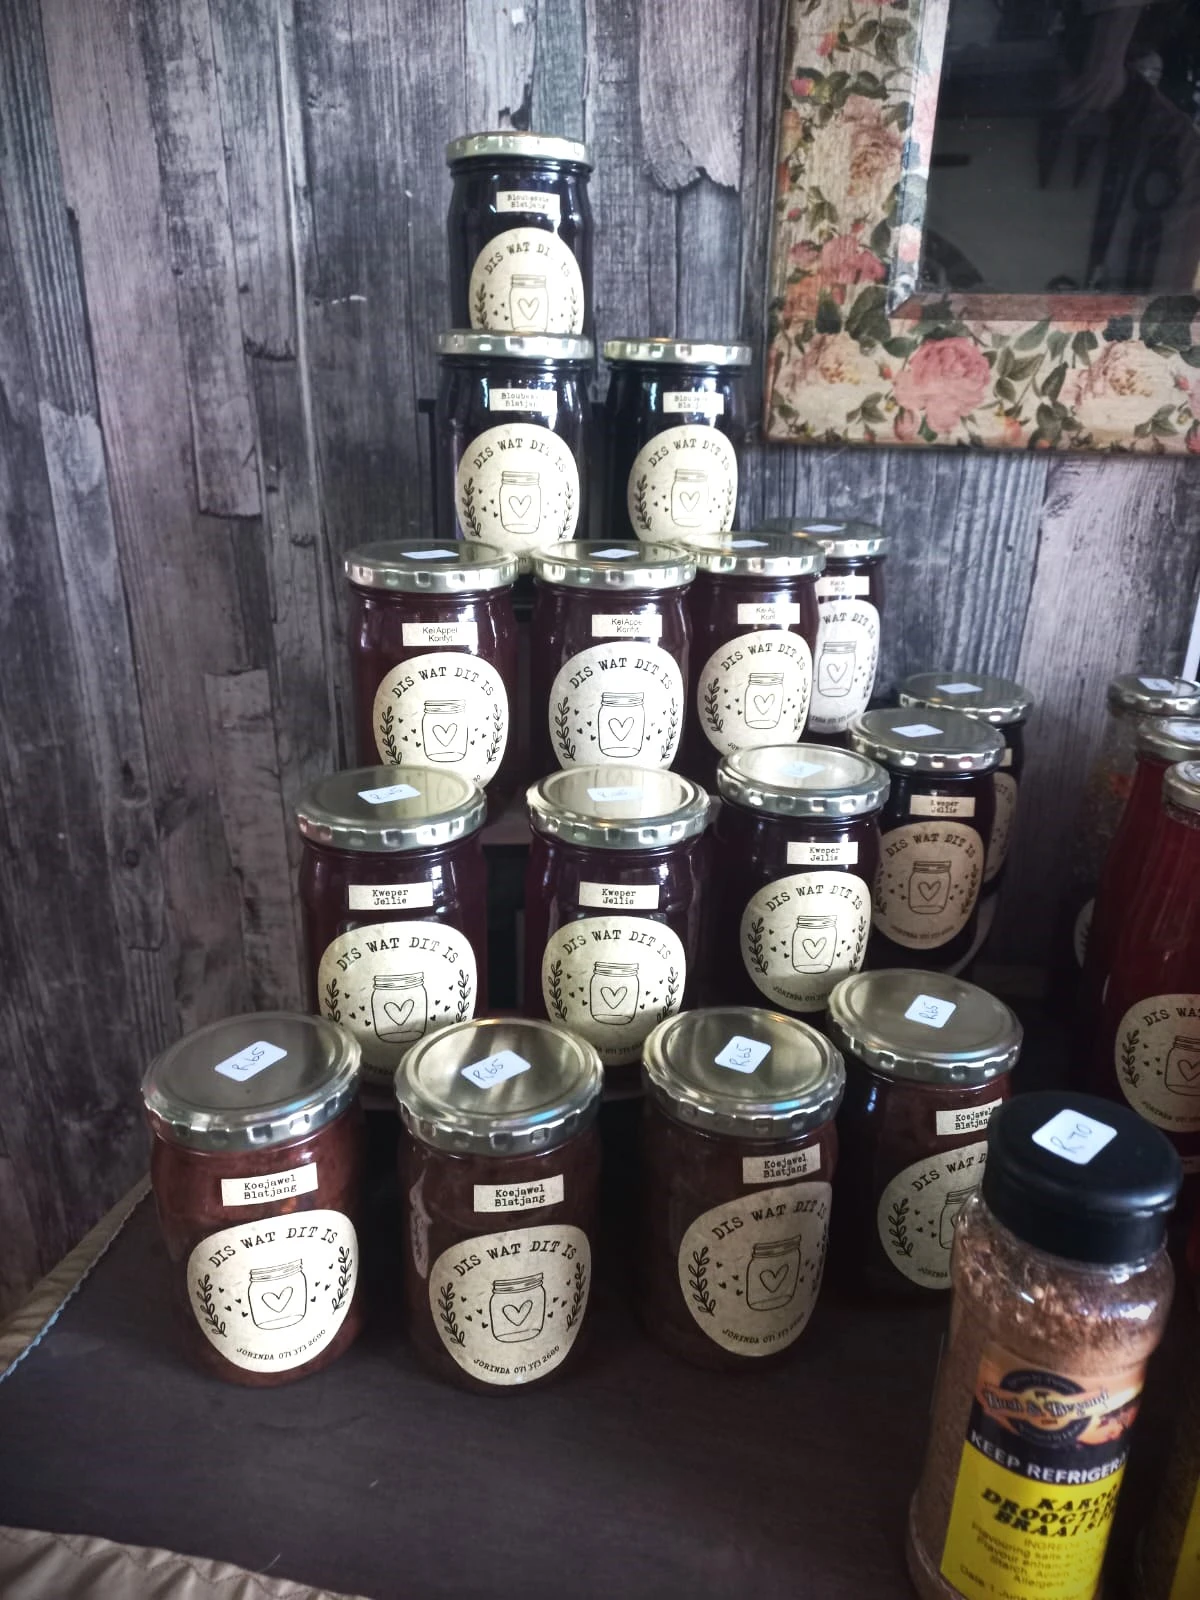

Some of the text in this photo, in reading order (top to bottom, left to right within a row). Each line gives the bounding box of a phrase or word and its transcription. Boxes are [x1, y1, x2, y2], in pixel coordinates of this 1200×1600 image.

[484, 252, 504, 275] DIS
[506, 241, 530, 254] WAT
[473, 447, 494, 470] DIS
[497, 438, 523, 451] WAT
[648, 446, 669, 468] DIS
[673, 438, 697, 450] WAT
[823, 612, 847, 625] WAT
[852, 612, 869, 627] DIT
[721, 650, 743, 671] DIS
[747, 642, 773, 656] WAT
[777, 643, 797, 658] DIT
[392, 666, 495, 699] DIS WAT DIT IS
[569, 657, 673, 690] DIS WAT DIT IS
[809, 846, 840, 856] Kweper
[885, 832, 976, 858] DIS WAT DIT IS
[810, 854, 839, 863] Jellie
[372, 888, 409, 899] Kweper
[373, 896, 407, 906] Jellie
[601, 888, 637, 898] Kweper
[602, 896, 635, 905] Jellie
[765, 884, 863, 912] DIS WAT DIT IS
[563, 929, 672, 960] DIS WAT DIT IS
[336, 936, 460, 972] DIS WAT DIT IS
[1143, 1009, 1170, 1027] DIS
[764, 1153, 808, 1169] Koejawel
[763, 1162, 808, 1179] Blatjang
[911, 1169, 941, 1192] DIS
[946, 1155, 974, 1175] WAT
[244, 1174, 297, 1191] Koejawel
[495, 1184, 545, 1198] Koejawel
[243, 1183, 298, 1201] Blatjang
[494, 1193, 546, 1207] Blatjang
[711, 1216, 744, 1240] DIS
[751, 1203, 787, 1222] WAT
[793, 1199, 818, 1214] DIT
[208, 1226, 338, 1268] DIS WAT DIT IS
[453, 1240, 577, 1278] DIS WAT DIT IS
[236, 1347, 275, 1361] JORINDA
[473, 1357, 510, 1375] JORINDA
[971, 1429, 1021, 1468] KEEP
